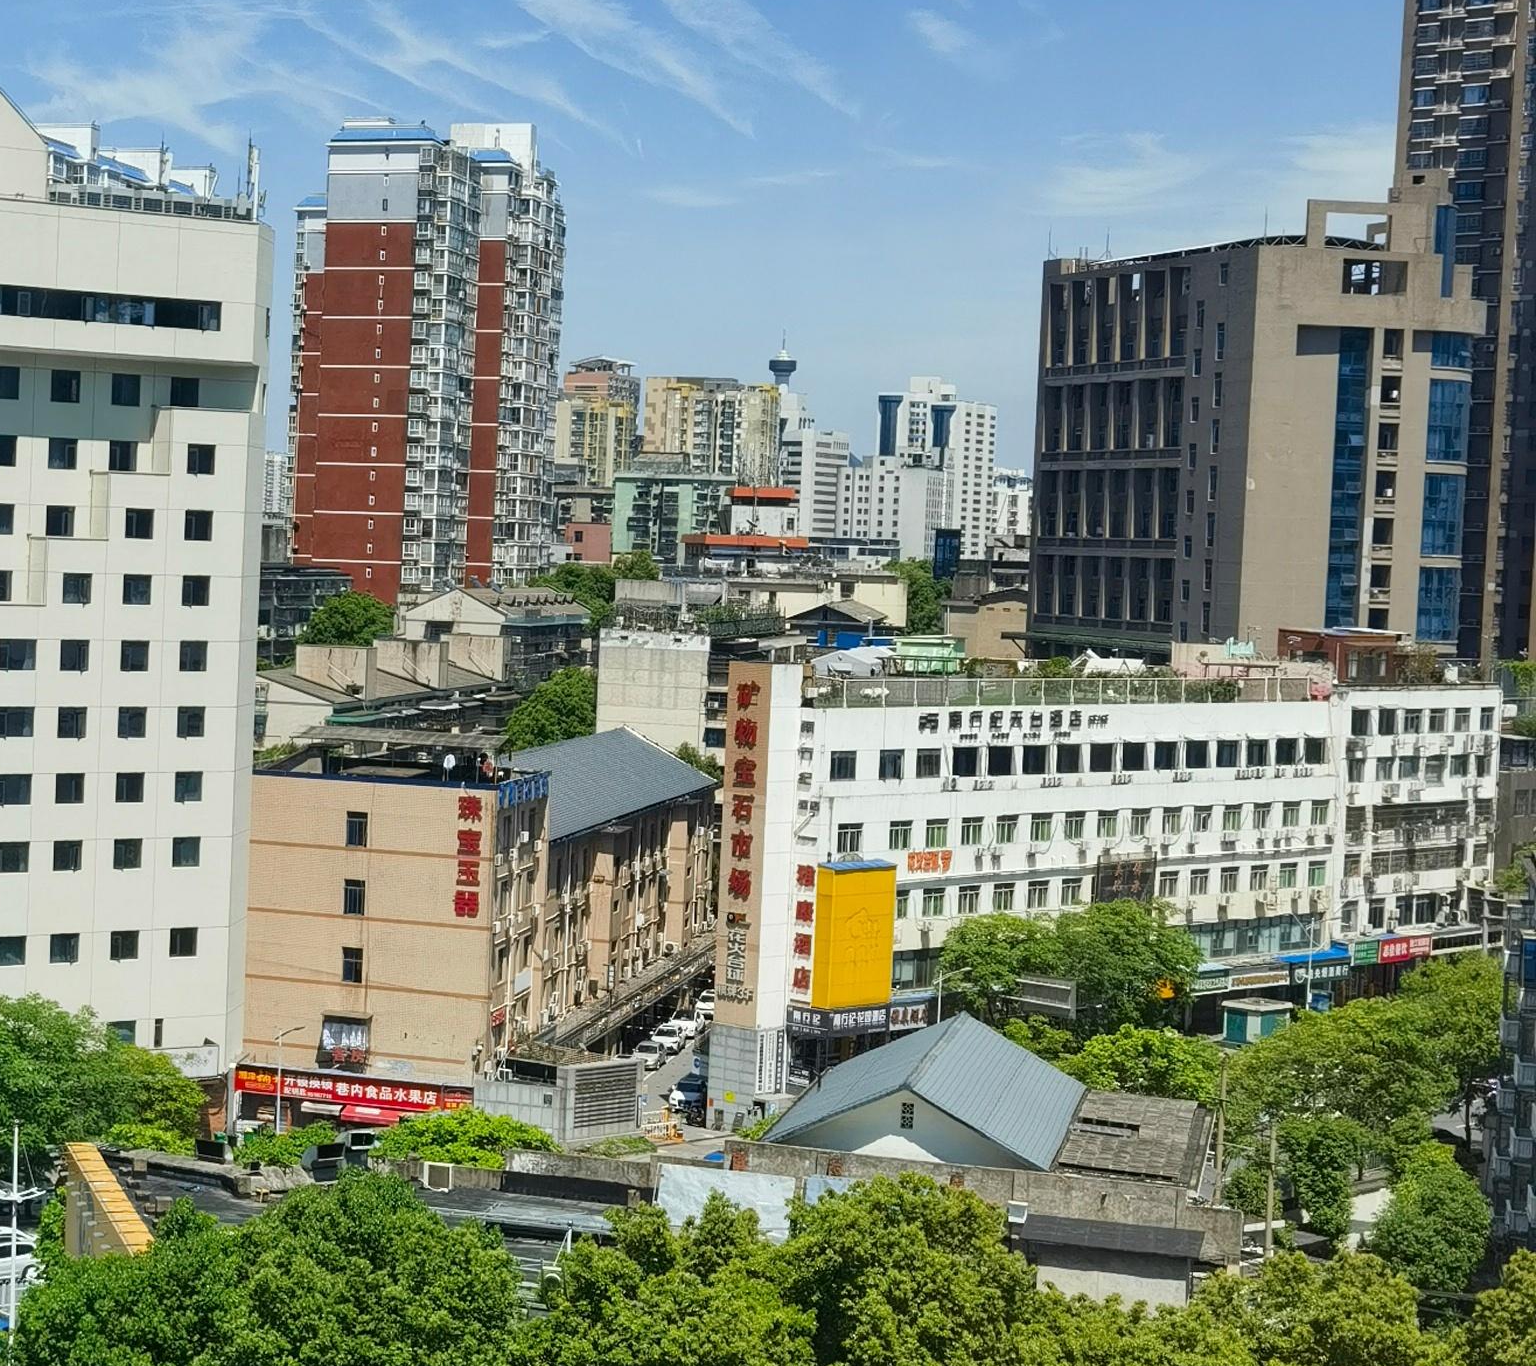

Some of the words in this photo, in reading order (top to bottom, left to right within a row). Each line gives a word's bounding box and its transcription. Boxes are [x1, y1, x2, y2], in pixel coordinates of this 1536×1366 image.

[728, 681, 760, 902] 矿物宝石市场
[454, 795, 482, 919] 珠宝玉器
[336, 1082, 437, 1106] 巷内食品水果店
